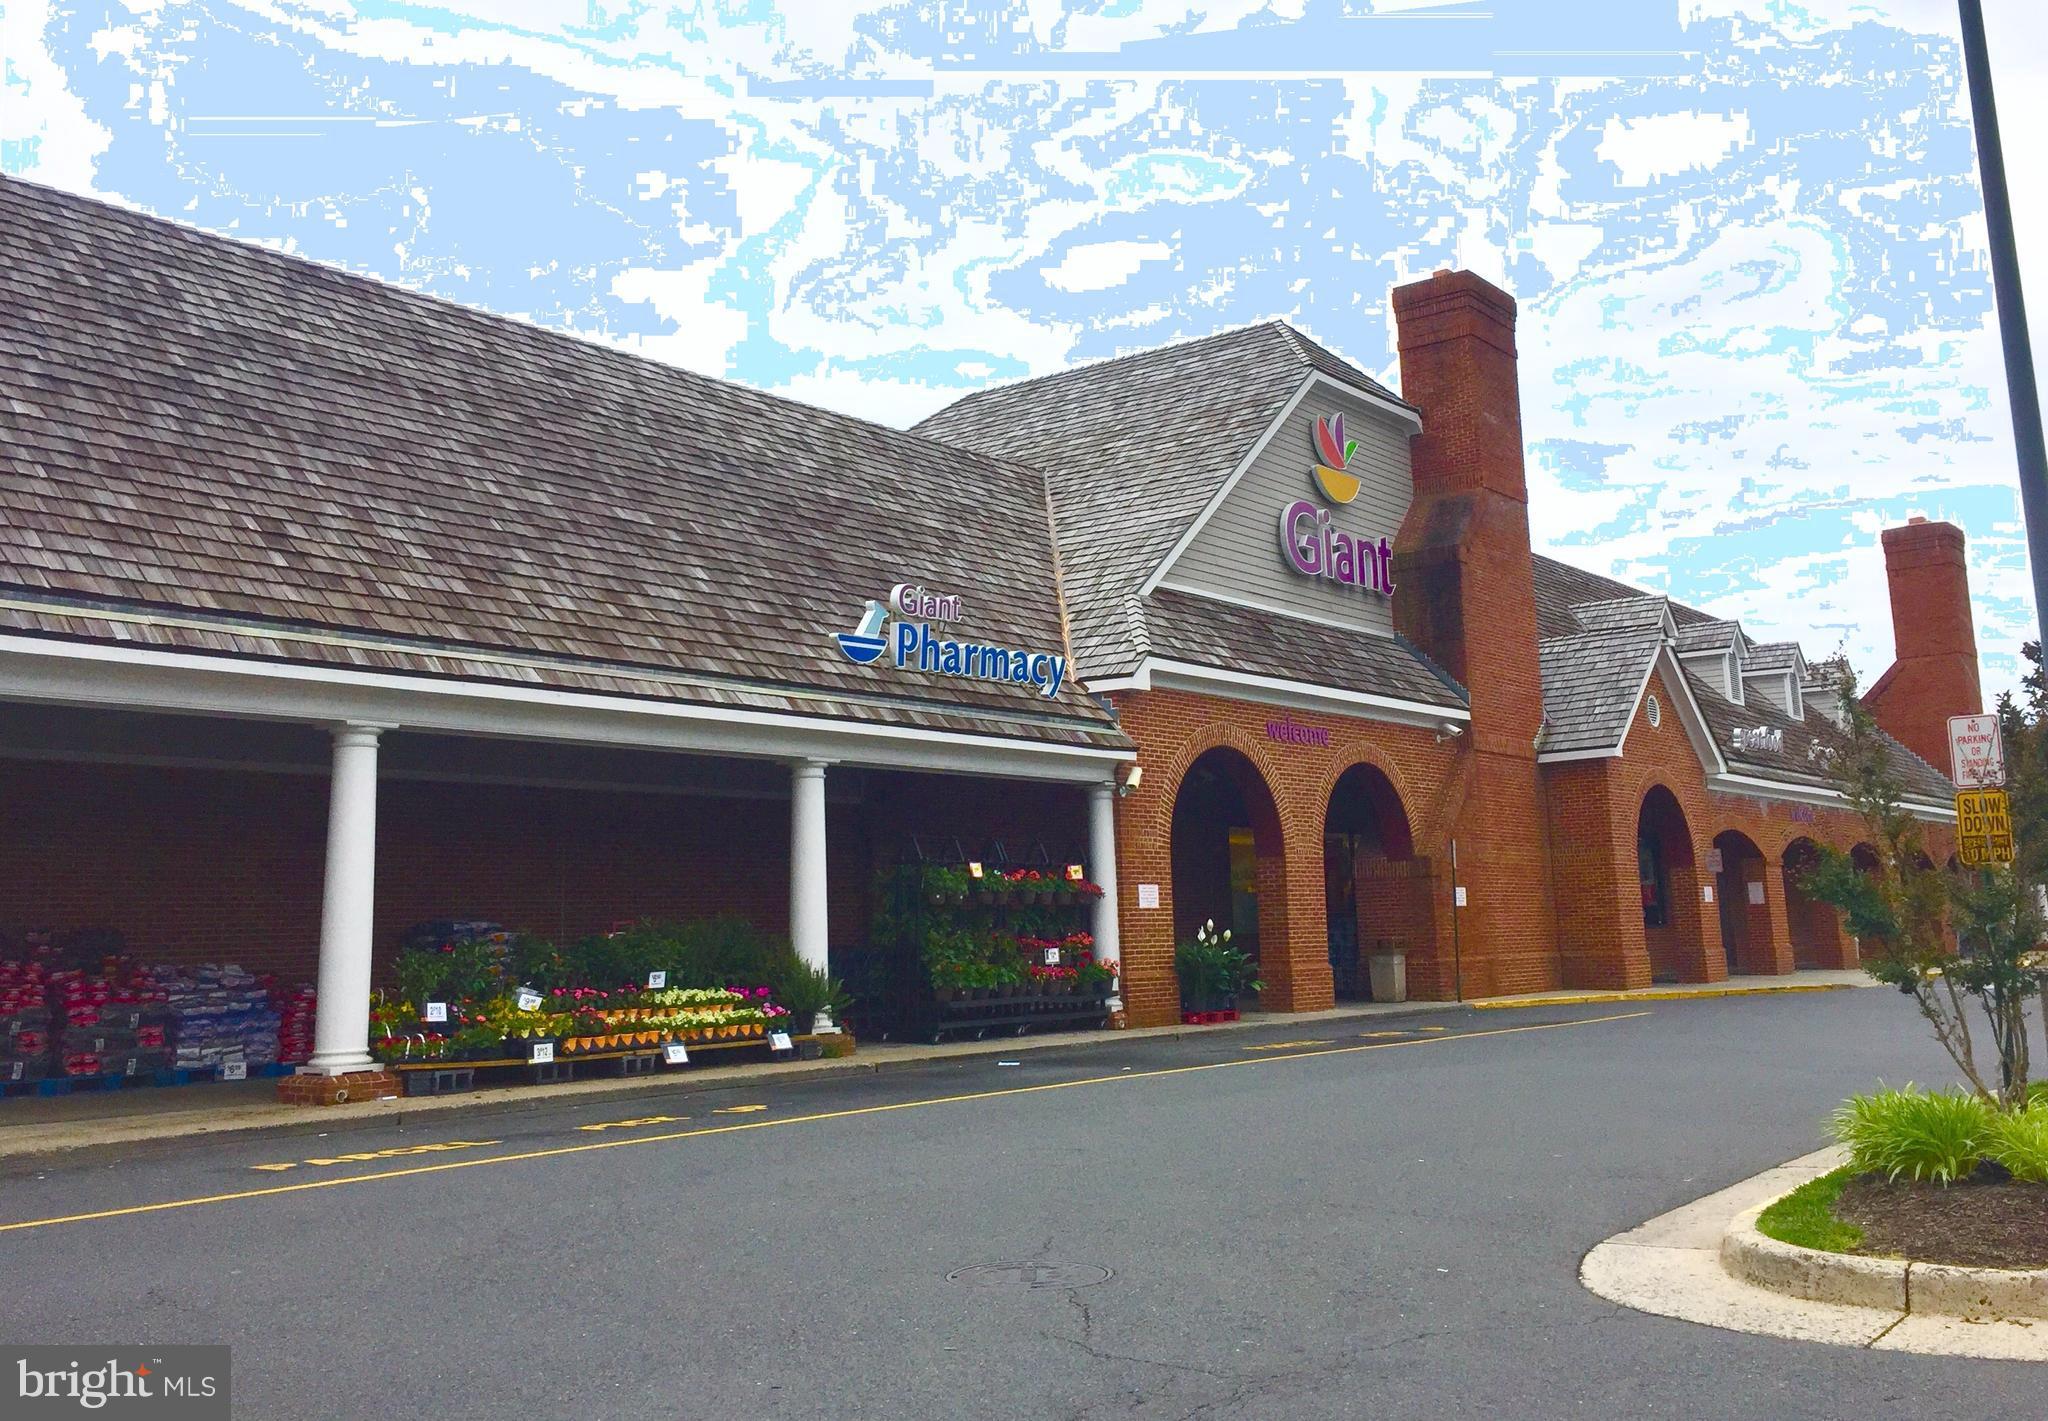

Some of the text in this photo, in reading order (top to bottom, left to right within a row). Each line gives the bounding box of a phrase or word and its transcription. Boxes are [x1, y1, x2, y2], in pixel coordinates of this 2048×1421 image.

[1280, 501, 1397, 597] Giant
[891, 584, 962, 622] Giant
[892, 622, 1066, 698] Pharmacy
[1265, 716, 1329, 748] welcome
[1967, 723, 1979, 732] NO
[1957, 735, 1992, 744] PARKING
[1971, 747, 1981, 756] OR
[1963, 797, 2001, 814] SLOW
[1964, 815, 2004, 833] DOWN
[1981, 847, 2011, 861] MPH
